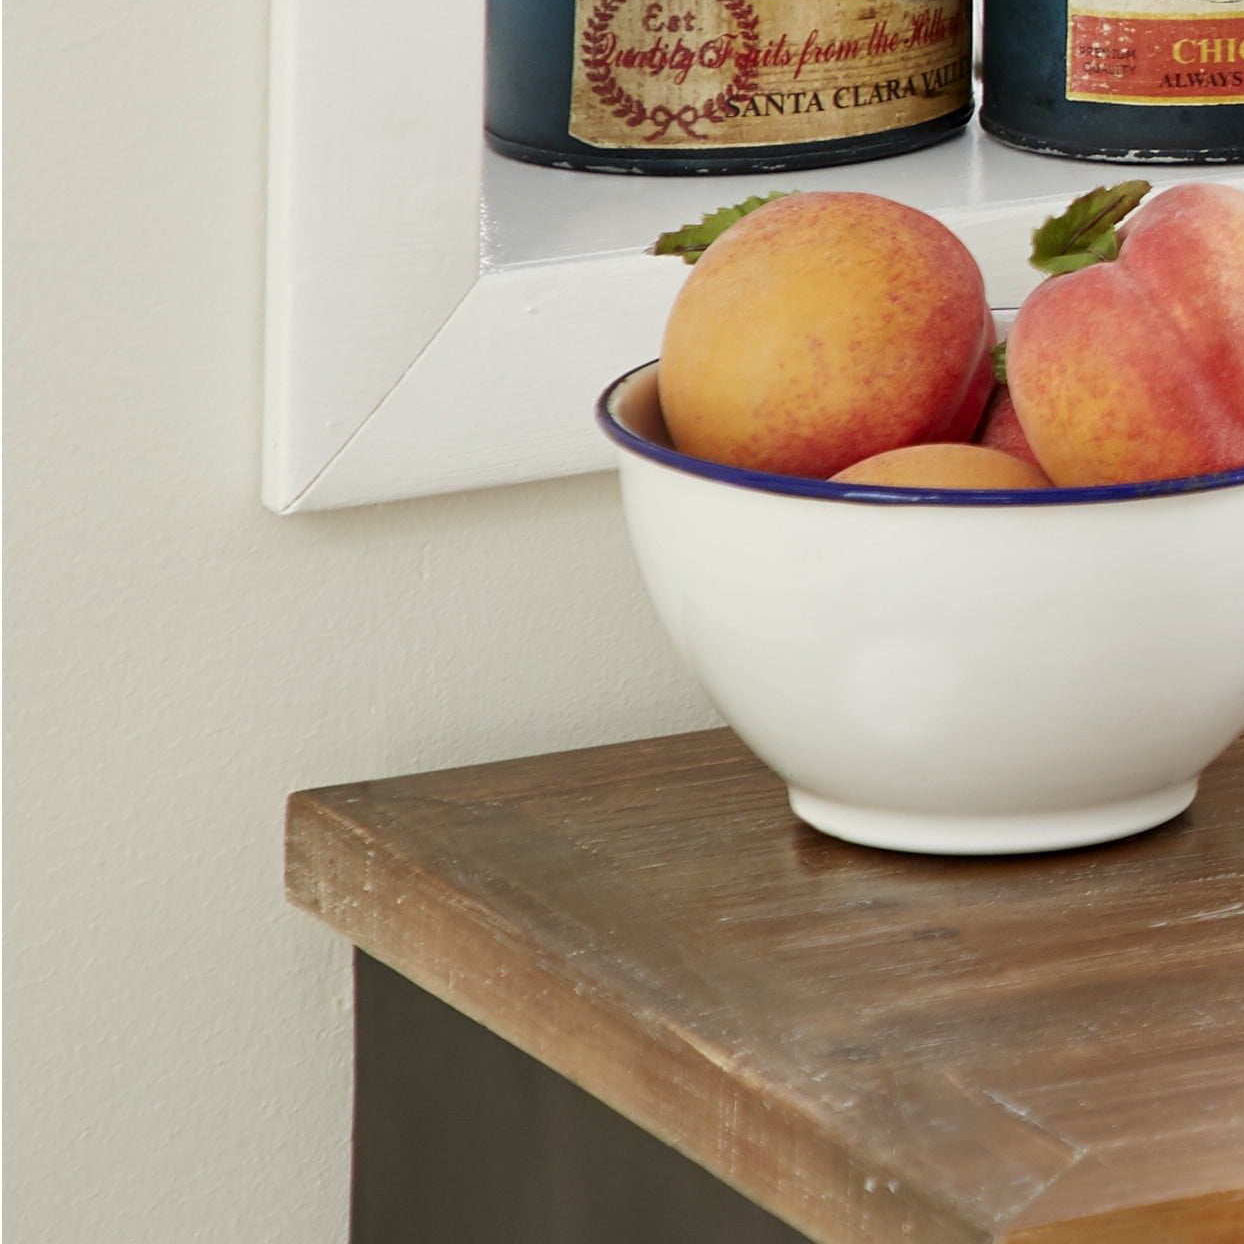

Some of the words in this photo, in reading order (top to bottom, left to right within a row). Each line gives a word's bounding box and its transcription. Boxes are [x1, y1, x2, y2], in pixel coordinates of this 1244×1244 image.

[793, 29, 859, 79] from
[867, 20, 898, 55] the
[1159, 68, 1243, 89] ALWAYS
[725, 92, 825, 118] SANTA
[833, 76, 917, 108] CLARA
[921, 57, 971, 94] VALLE
